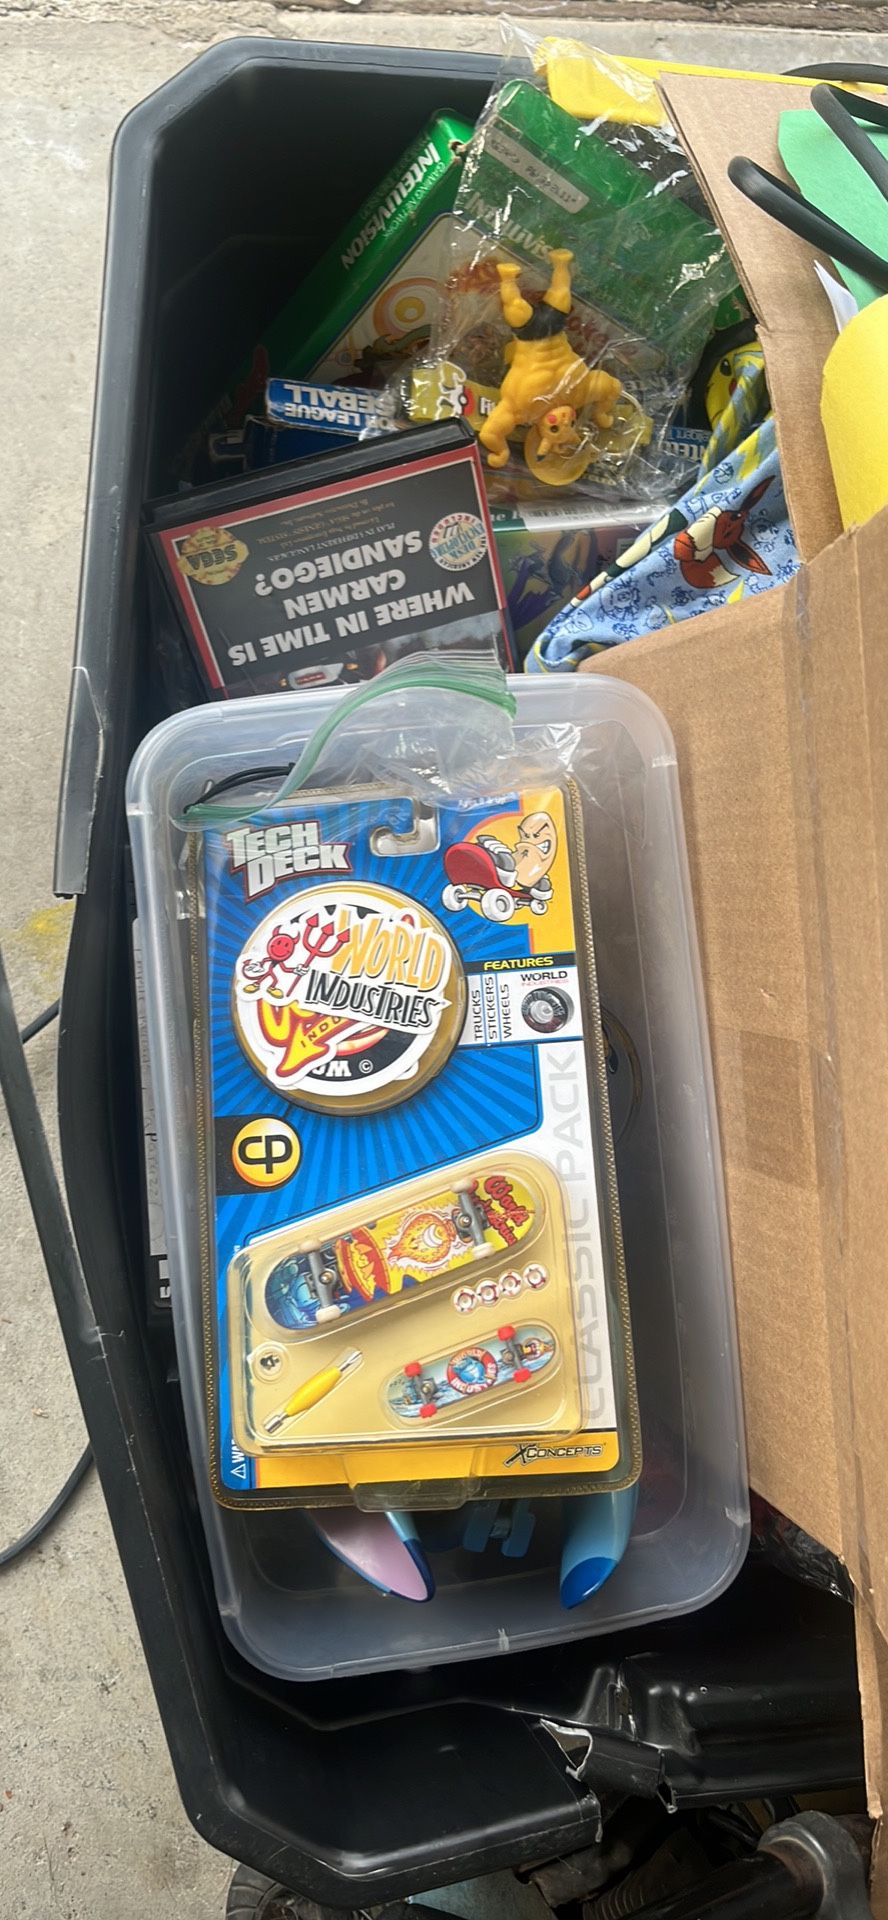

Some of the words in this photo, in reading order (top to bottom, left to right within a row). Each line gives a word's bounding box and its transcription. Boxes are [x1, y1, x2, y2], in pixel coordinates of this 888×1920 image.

[284, 402, 361, 427] LEAGUE
[186, 543, 238, 571] SEGA
[255, 530, 423, 596] SANDIEGO?
[282, 568, 406, 620] CARMEN
[373, 582, 475, 626] WHERE
[260, 622, 331, 658] TIME
[335, 611, 370, 637] IN
[227, 641, 258, 666] IS
[226, 822, 318, 868] TECH
[247, 844, 349, 897] DECK
[331, 907, 446, 993] WORLD
[483, 956, 554, 971] FEATURES
[520, 970, 568, 982] WORLD
[304, 969, 441, 1028] INDUSTRIES
[471, 989, 484, 1041] TRUCKS
[484, 976, 498, 1040] STICKERS
[500, 983, 512, 1039] WHEELS
[546, 1043, 586, 1181] PACK
[562, 1197, 605, 1421] CLASSIC
